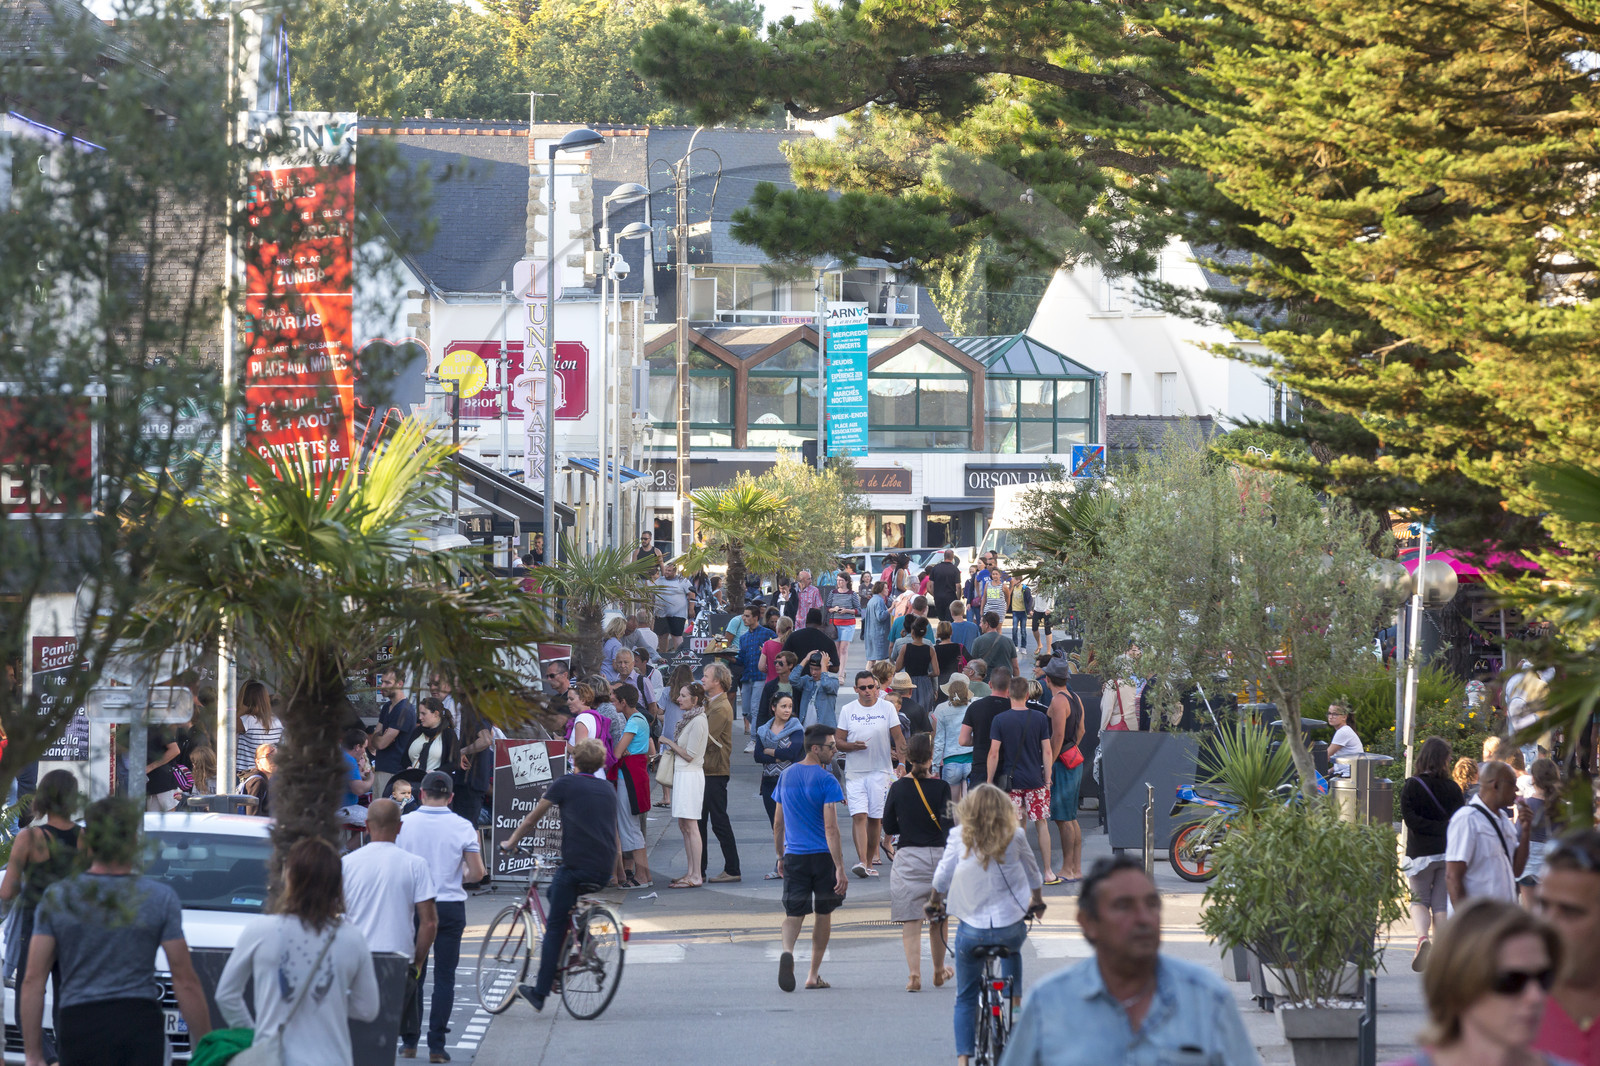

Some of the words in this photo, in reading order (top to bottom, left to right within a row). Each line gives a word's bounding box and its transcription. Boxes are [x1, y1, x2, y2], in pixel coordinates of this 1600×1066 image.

[832, 329, 868, 338] MERCREDIS
[455, 354, 472, 363] BAR
[251, 360, 286, 378] PLACE
[287, 358, 309, 374] AUX
[442, 365, 483, 375] BILLARDS
[831, 411, 868, 420] WEEK-ENDS
[968, 471, 1022, 489] ORSON
[851, 713, 866, 722] Pepe
[865, 713, 887, 723] Jeans
[522, 748, 545, 763] Tour
[496, 815, 561, 830] Sandches
[498, 860, 506, 872] à
